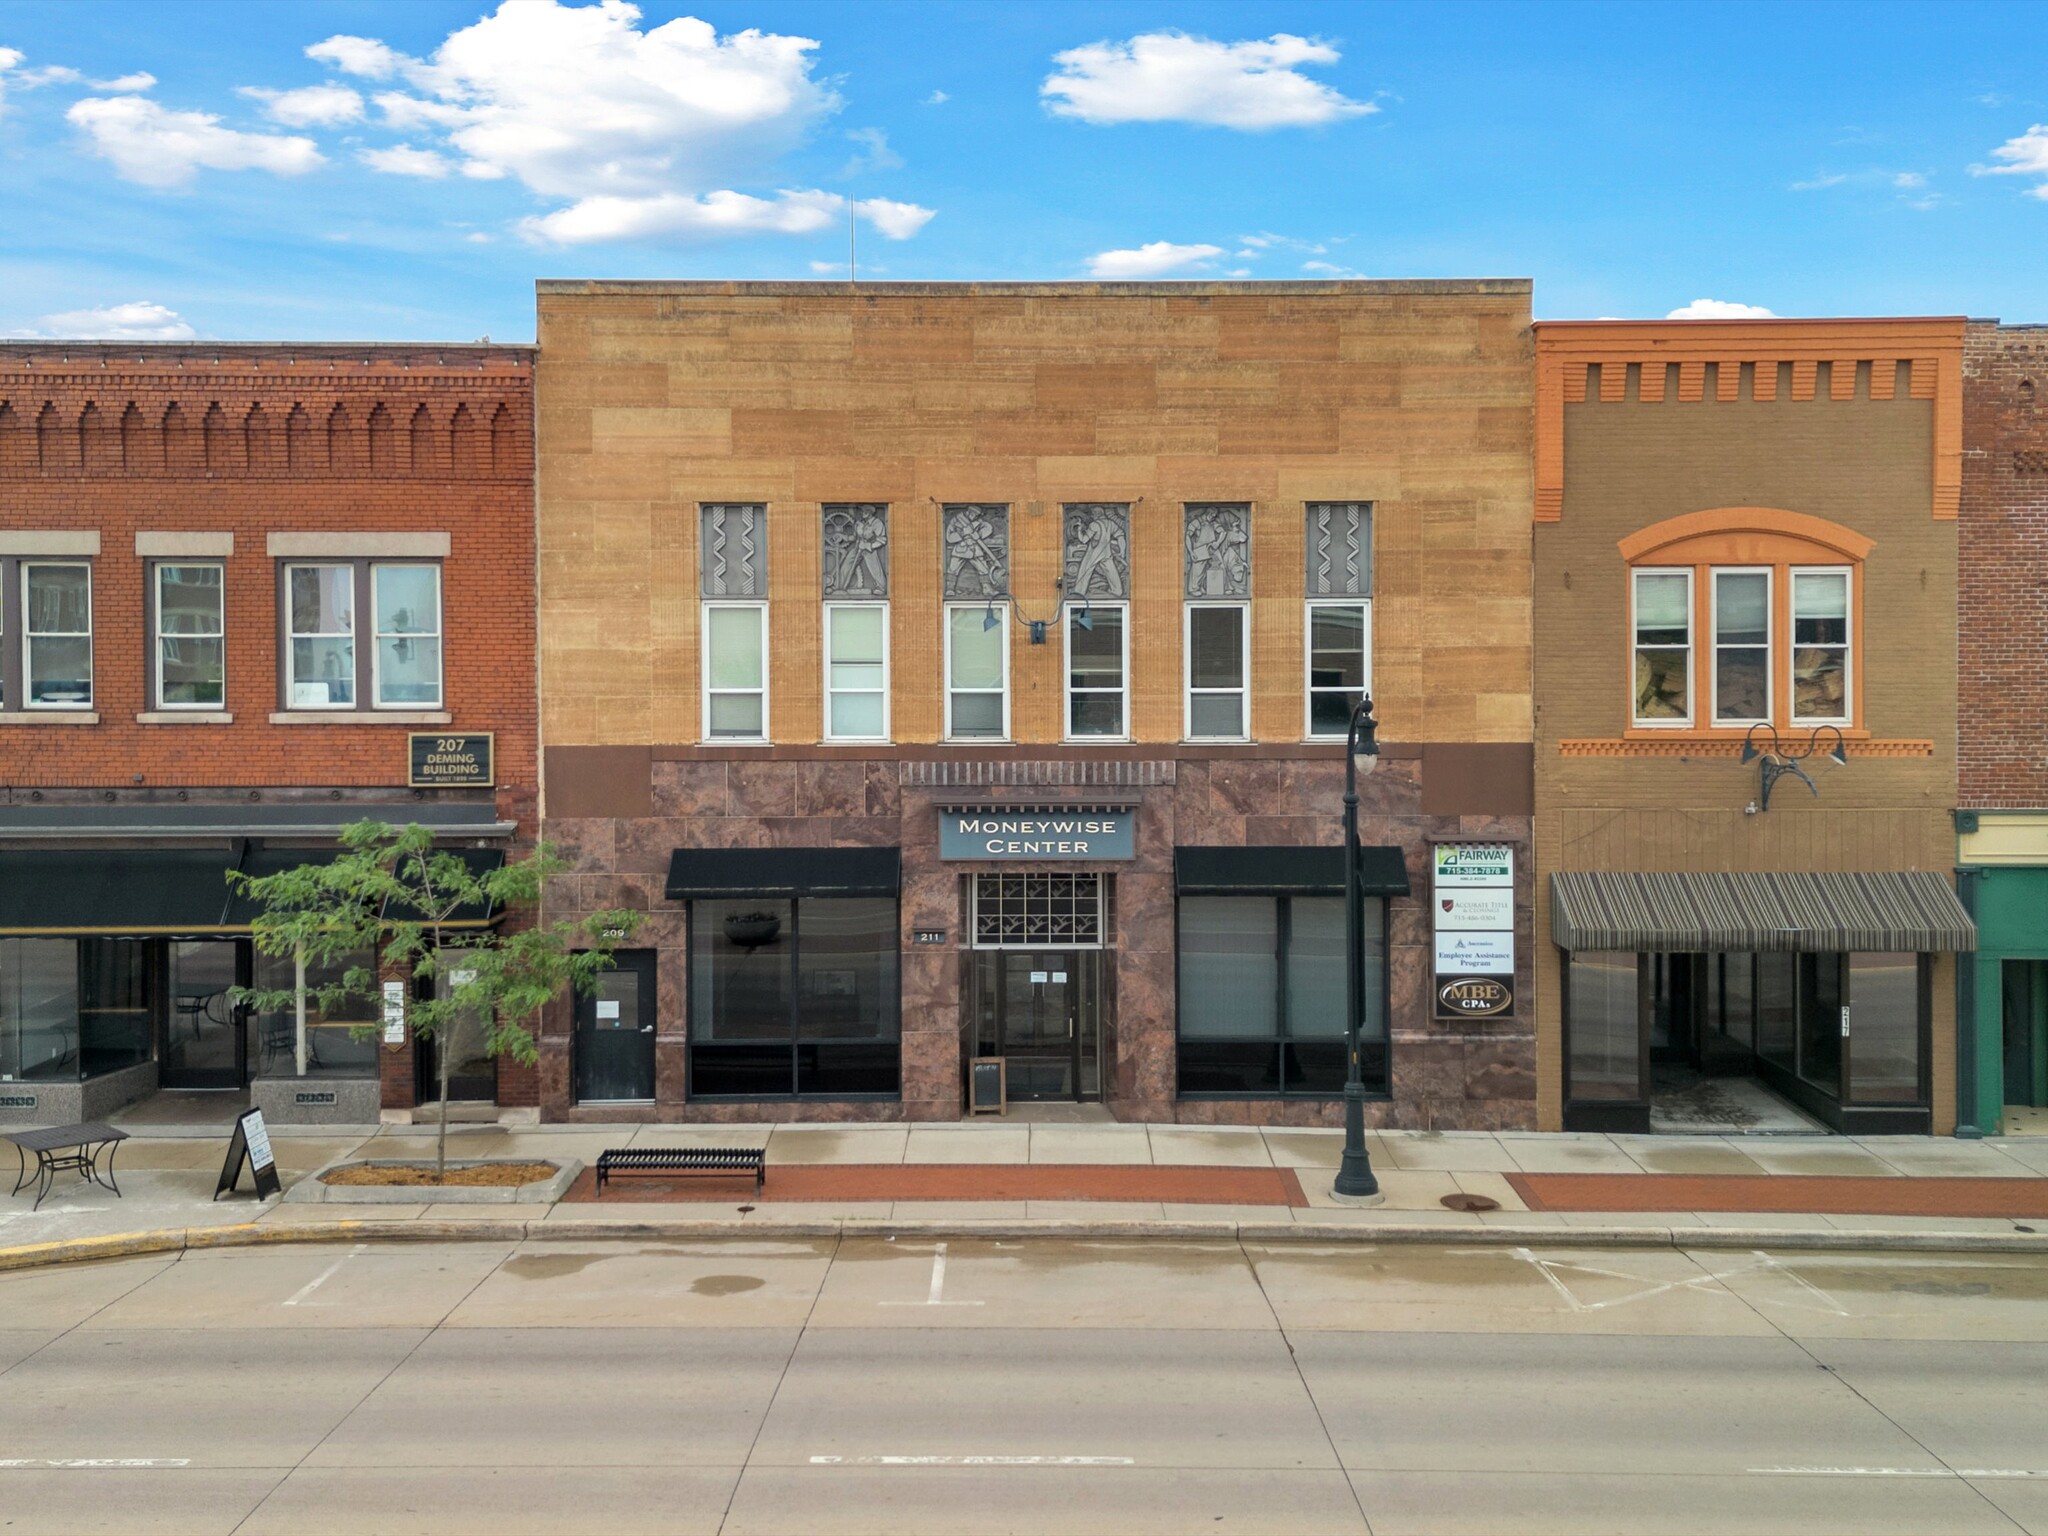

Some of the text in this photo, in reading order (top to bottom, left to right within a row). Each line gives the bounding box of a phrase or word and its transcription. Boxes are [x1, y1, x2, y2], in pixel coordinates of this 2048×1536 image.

[437, 739, 465, 752] 207
[428, 754, 475, 764] DEMING
[424, 765, 479, 775] BUILDING
[959, 819, 1116, 834] MONEYWISE
[986, 839, 1088, 854] CENTER
[1459, 850, 1508, 861] FAIRWAY
[602, 929, 625, 937] 209
[920, 933, 939, 942] 211
[1450, 984, 1500, 999] MBE
[1462, 999, 1491, 1008] CPAs
